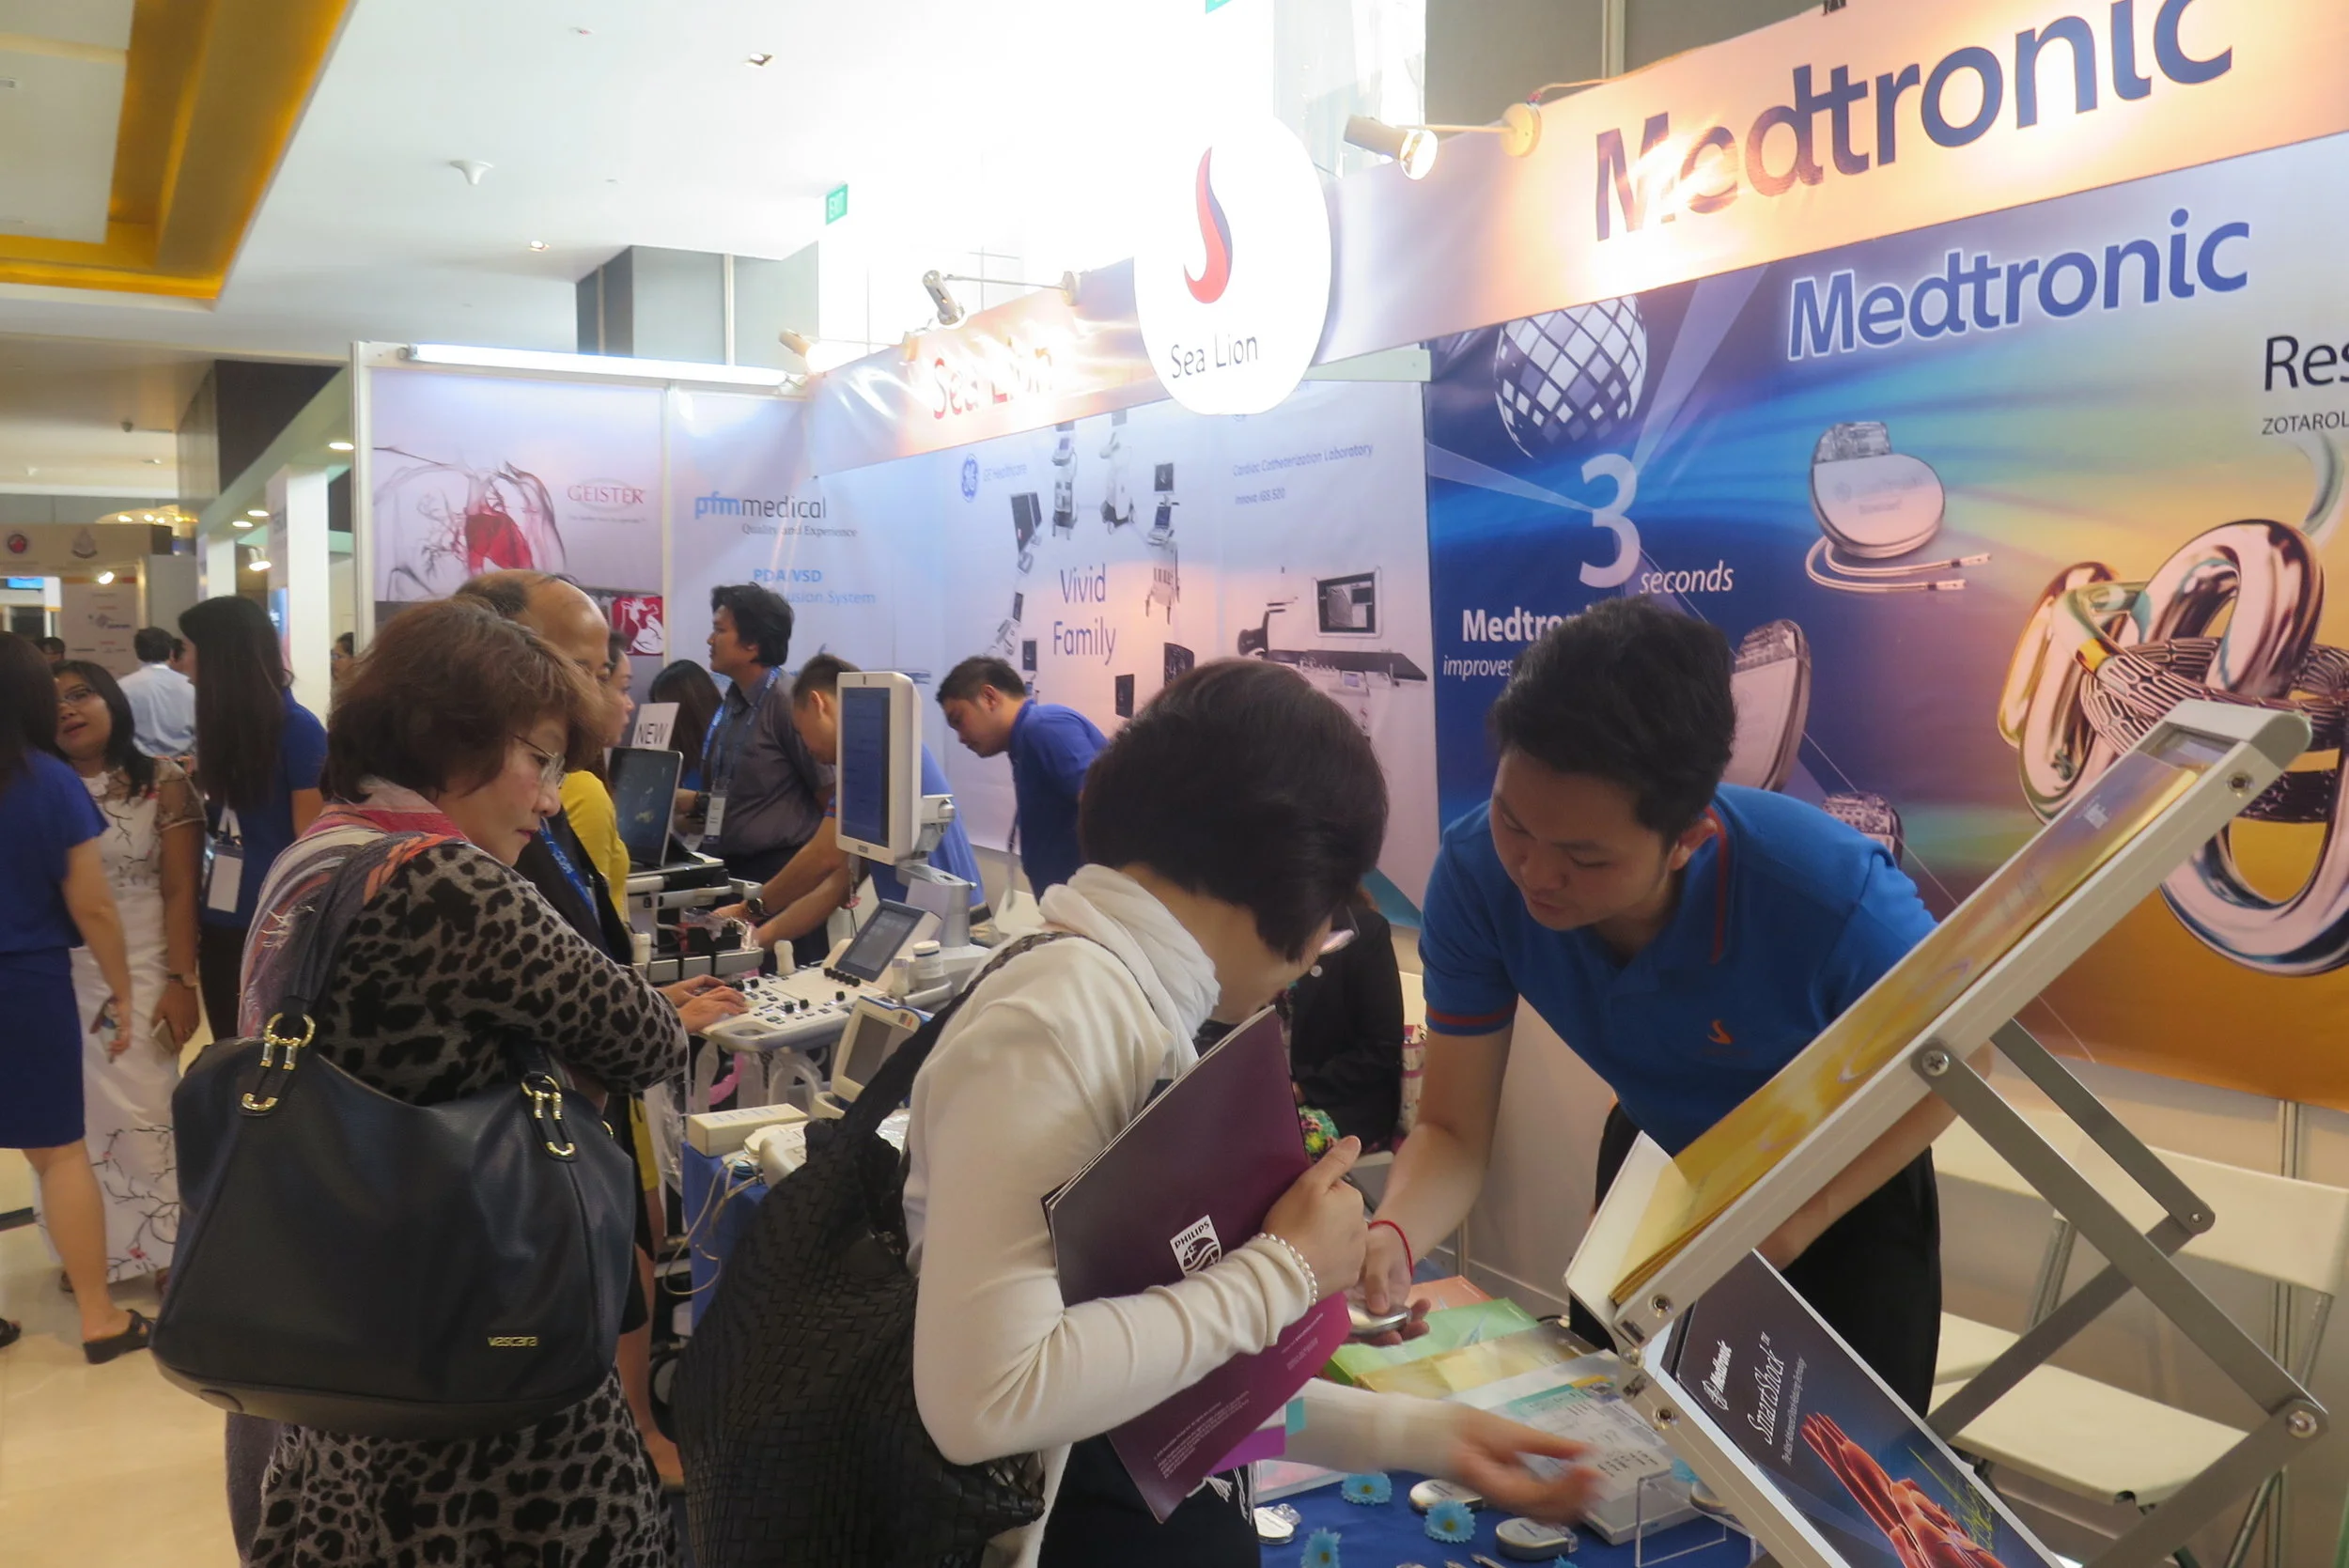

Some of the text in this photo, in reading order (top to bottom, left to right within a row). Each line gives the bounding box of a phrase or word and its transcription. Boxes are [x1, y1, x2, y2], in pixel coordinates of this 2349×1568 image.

[1596, 0, 2233, 241] Medtronic
[1789, 209, 2250, 360] Medtronic
[1171, 334, 1258, 379] Sea Lion
[2262, 411, 2349, 435] ZOTAROL
[1324, 442, 1373, 461] Laboratory
[568, 485, 644, 505] GEISTER
[742, 523, 857, 537] Quality and Experience
[1579, 453, 1641, 588] 3
[1060, 563, 1106, 603] Vivid
[1639, 560, 1735, 595] seconds
[828, 591, 876, 606] System
[1053, 615, 1116, 666] Family
[635, 722, 669, 744] NEW
[1174, 1221, 1209, 1250] PHILIPS
[487, 1336, 538, 1348] vascara
